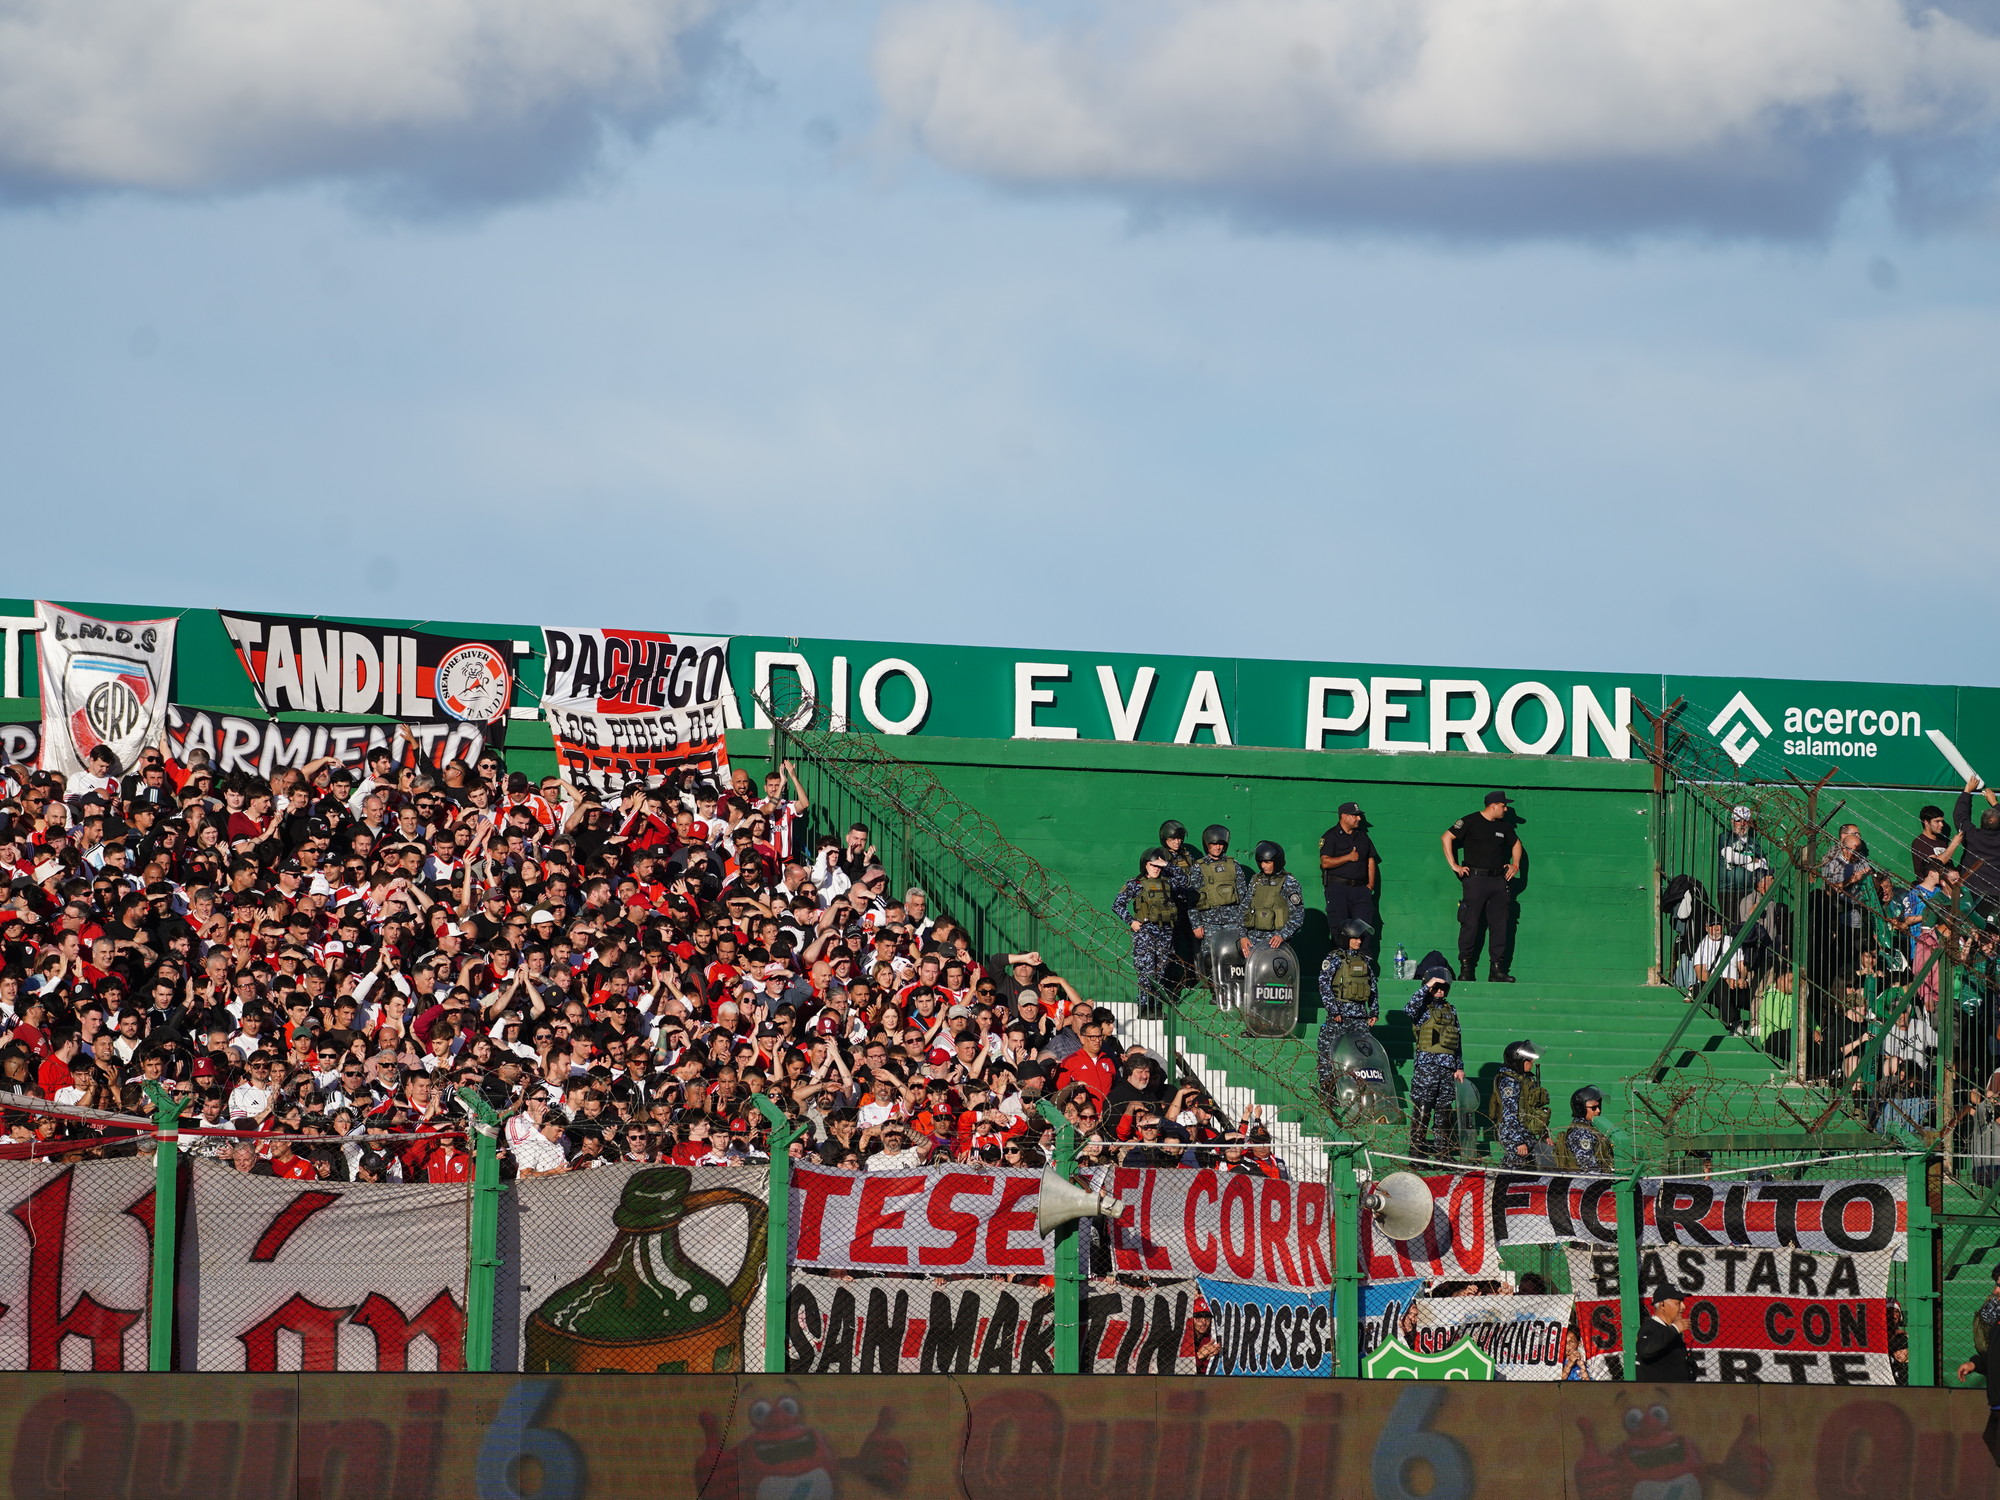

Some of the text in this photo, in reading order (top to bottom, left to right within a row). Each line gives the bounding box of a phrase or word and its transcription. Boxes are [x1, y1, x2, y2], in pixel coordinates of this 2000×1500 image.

[221, 615, 434, 717] TANDIL
[441, 650, 489, 699] SIEMPRE RIVER
[466, 679, 504, 719] TANDIL
[545, 629, 725, 708] PACHECO
[552, 706, 718, 753] LOS PIBES DE
[1014, 662, 1232, 745] EVA
[1305, 676, 1632, 759] PERON
[1784, 707, 1921, 737] acercon
[1784, 737, 1878, 758] salamone
[1256, 986, 1293, 1000] POLICIA
[791, 1168, 1094, 1266] TESE
[1114, 1168, 1486, 1287] EL CORRLTO
[1492, 1173, 1897, 1252] FIORITO
[1593, 1249, 1861, 1298] BASTARA
[787, 1283, 1196, 1375] SAN MARTIN
[1591, 1300, 1870, 1350] SO CON
[474, 1378, 588, 1500] 6
[1371, 1384, 1476, 1500] 6
